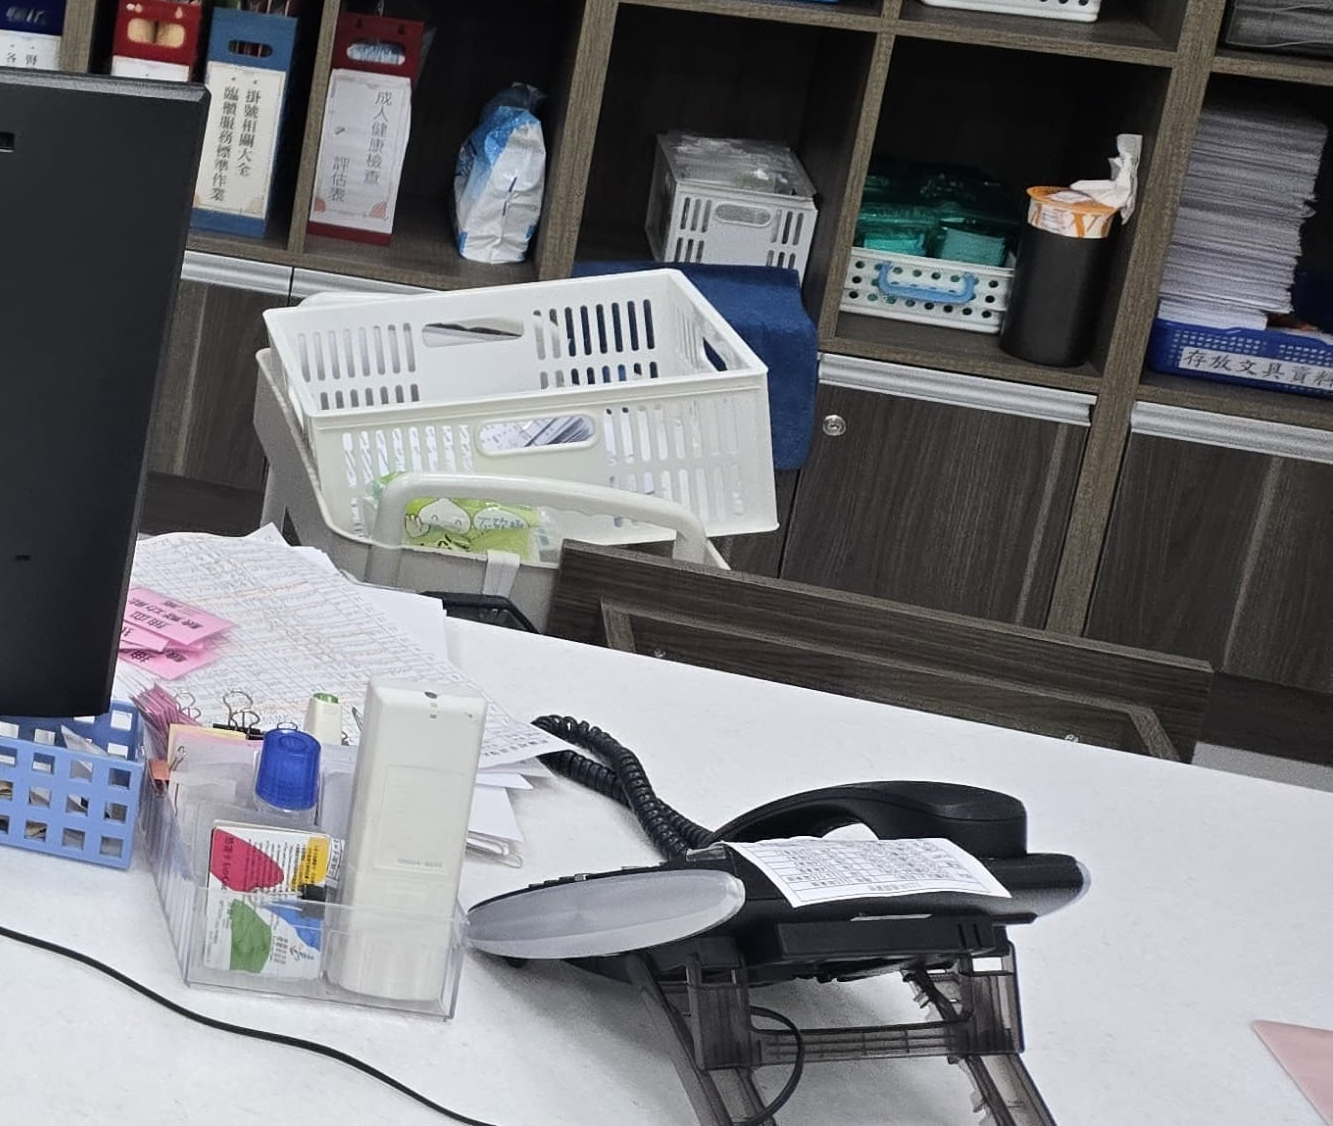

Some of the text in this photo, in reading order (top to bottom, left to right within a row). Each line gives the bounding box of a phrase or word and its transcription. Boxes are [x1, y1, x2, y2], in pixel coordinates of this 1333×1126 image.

[237, 89, 261, 177] 掛號相關大全
[363, 91, 393, 186] 成人健康檢查
[327, 155, 350, 203] 評估表
